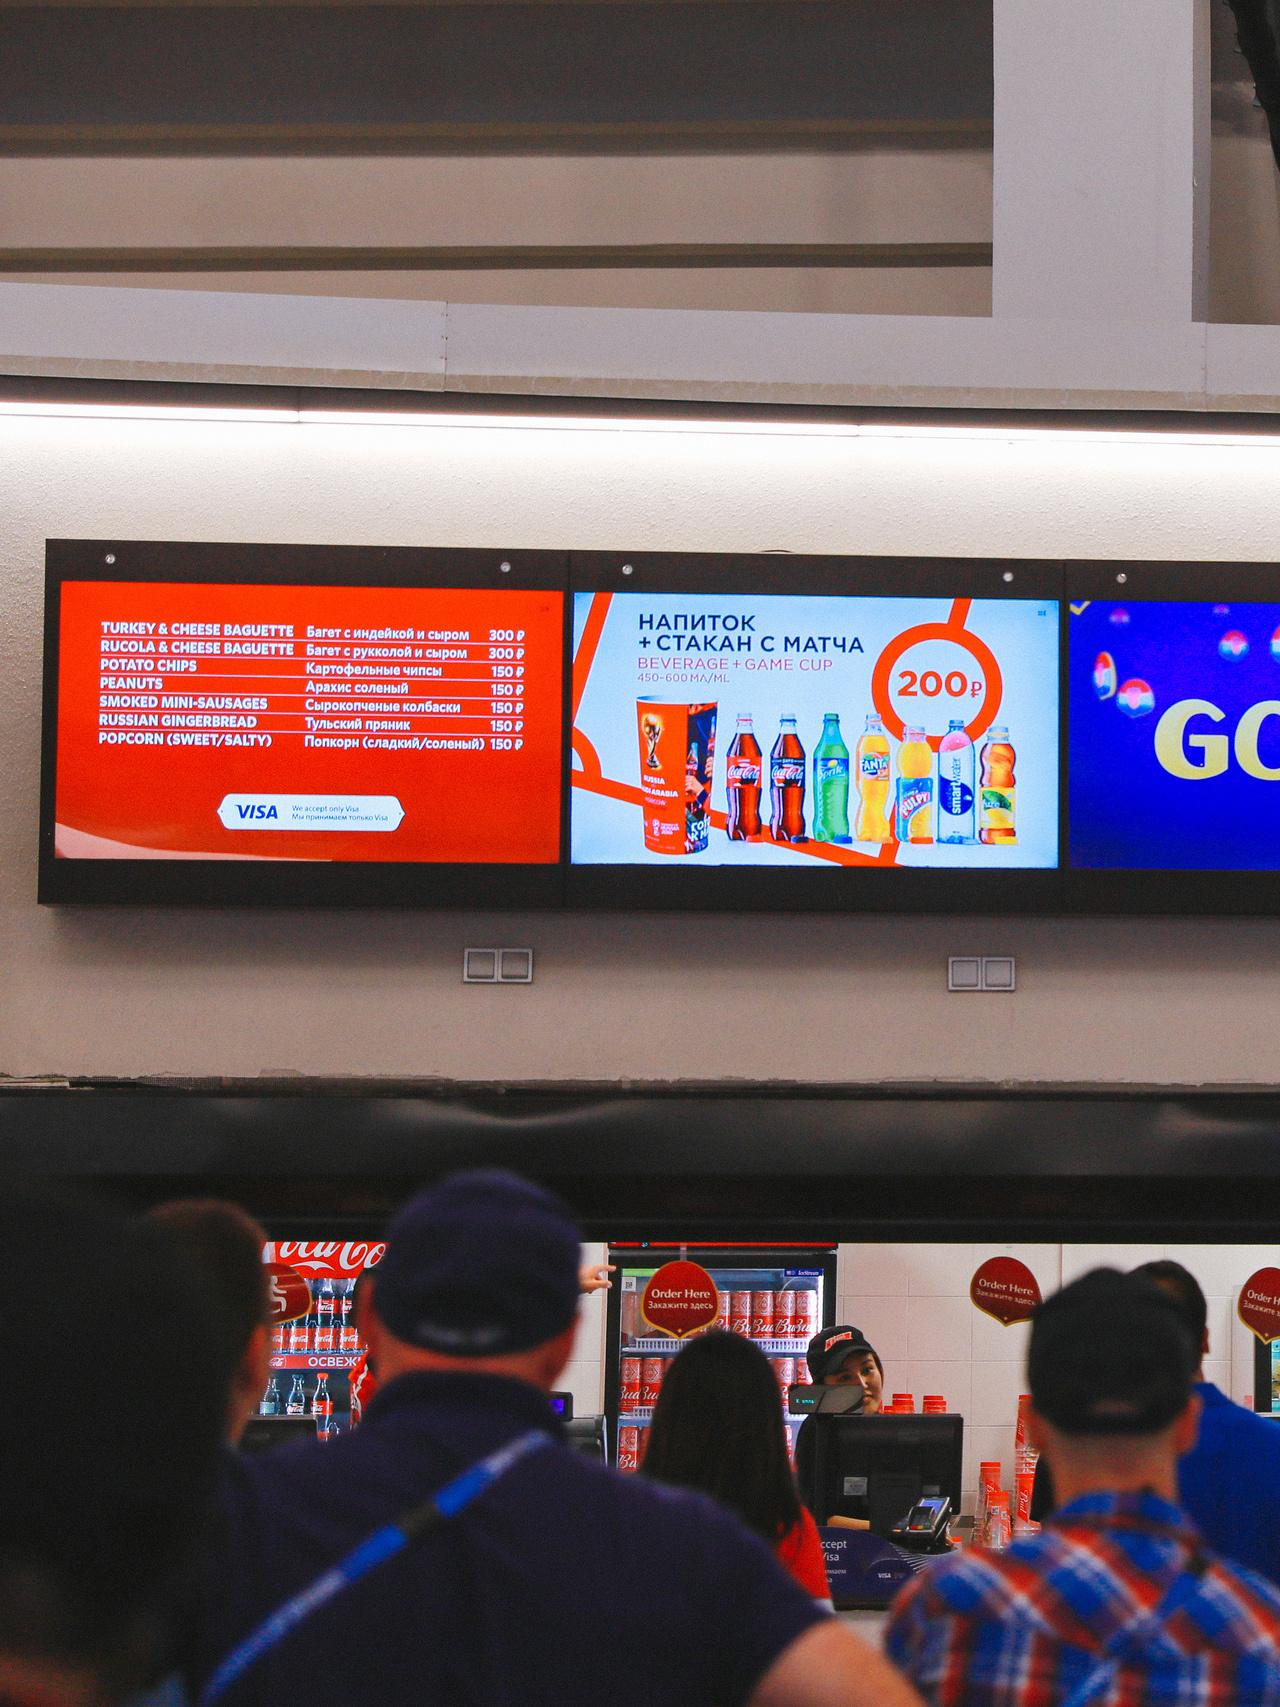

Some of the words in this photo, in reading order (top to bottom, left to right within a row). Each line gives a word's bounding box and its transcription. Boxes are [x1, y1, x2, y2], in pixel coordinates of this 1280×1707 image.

[101, 621, 156, 635] TURKEY
[158, 622, 168, 635] &
[171, 622, 221, 636] CHEESE
[224, 623, 294, 637] BAGUETTE
[639, 613, 756, 632] НАПИТОК
[307, 625, 342, 638] Багет
[344, 629, 351, 638] с
[353, 627, 414, 640] индейкой
[417, 630, 425, 640] и
[427, 630, 470, 641] сыром
[489, 629, 514, 641] 300
[101, 639, 156, 653] RUCOLA
[158, 640, 169, 653] &
[171, 641, 221, 654] CHEESE
[224, 642, 294, 656] BAGUETTE
[306, 643, 342, 656] Багет
[343, 647, 351, 656] с
[353, 645, 412, 658] рукколой
[415, 648, 423, 658] и
[425, 648, 467, 659] сыром
[639, 637, 651, 649] +
[656, 634, 752, 652] СТАКАН
[760, 636, 775, 652] С
[784, 636, 864, 654] МАТЧА
[488, 647, 514, 660] 300
[100, 658, 155, 671] POTATO
[157, 659, 197, 672] CHIPS
[306, 662, 401, 677] Картофельные
[403, 666, 442, 676] чипсы
[638, 657, 729, 670] BEVERAGE
[745, 658, 793, 671] GAME
[799, 659, 833, 671] CUP
[491, 665, 514, 678] 150
[637, 673, 688, 683] 450-600
[100, 676, 163, 690] PEANUTS
[305, 680, 352, 694] Арахис
[354, 681, 409, 694] соленый
[491, 683, 513, 696] 150
[99, 695, 158, 708] SMOKED
[161, 696, 268, 710] MINI-SAUSAGES
[305, 698, 400, 713] Сырокопченые
[403, 700, 461, 713] колбаски
[490, 701, 513, 714] 150
[99, 713, 158, 726] RUSSIAN
[161, 714, 257, 728] GINGERBREAD
[304, 716, 362, 731] Тульский
[365, 720, 411, 732] пряник
[490, 720, 513, 732] 150
[99, 732, 164, 745] POPCORN
[167, 732, 272, 748] (SWEET/SALTY)
[305, 735, 359, 750] Попкорн
[362, 736, 485, 752] (сладкий/соленый)
[490, 738, 512, 750] 150
[860, 758, 888, 771] FANTA
[820, 765, 843, 780] Sprite
[900, 792, 928, 817] PULPY
[234, 804, 278, 820] VISA
[651, 1288, 683, 1299] Order
[684, 1289, 711, 1299] Here
[979, 1278, 1008, 1290] Order
[1009, 1284, 1034, 1296] Here
[1247, 1289, 1273, 1303] Order
[648, 1301, 690, 1310] Закажите
[691, 1302, 714, 1310] здесь
[308, 1357, 361, 1368] ОСВЕЖ
[821, 1540, 847, 1550] ccept
